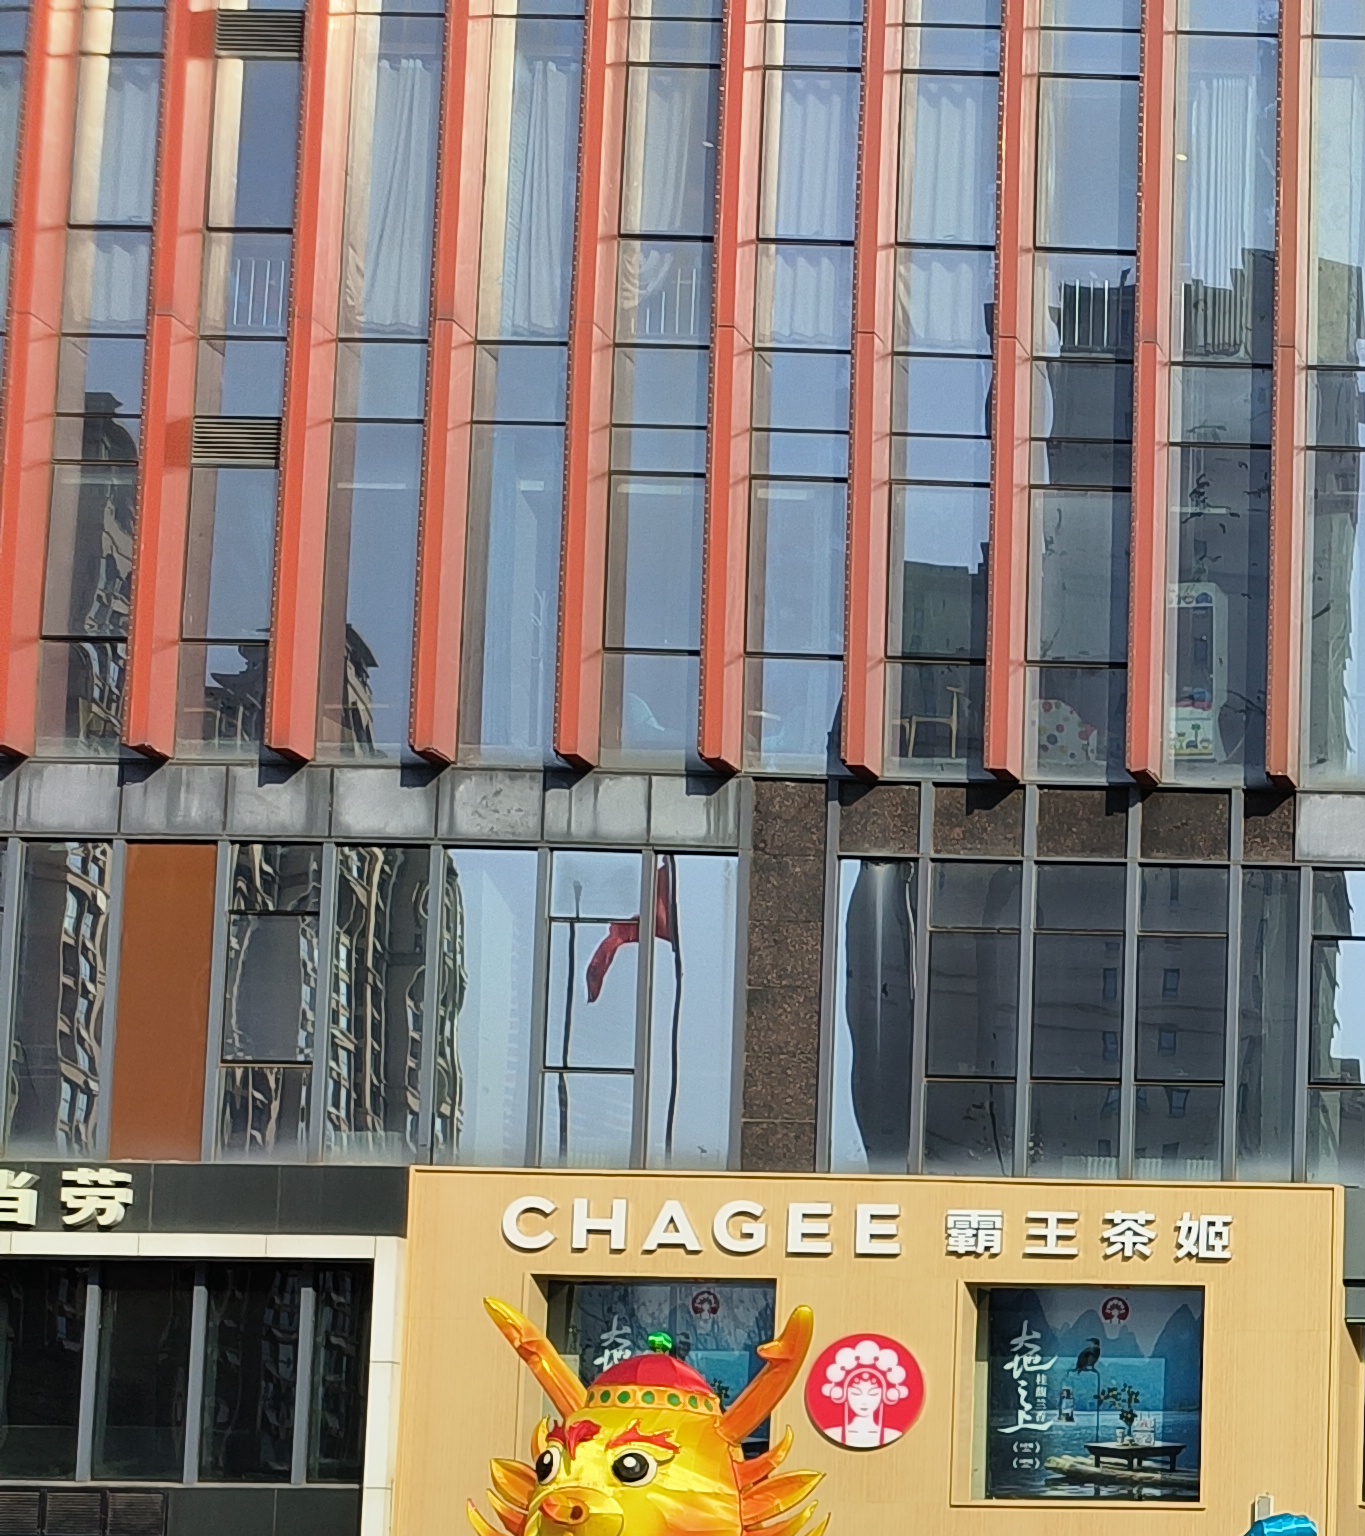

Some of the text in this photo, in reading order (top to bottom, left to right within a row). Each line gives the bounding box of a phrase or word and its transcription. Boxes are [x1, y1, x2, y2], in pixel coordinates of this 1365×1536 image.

[502, 1196, 1232, 1259] CHAGEE 霸王茶姬
